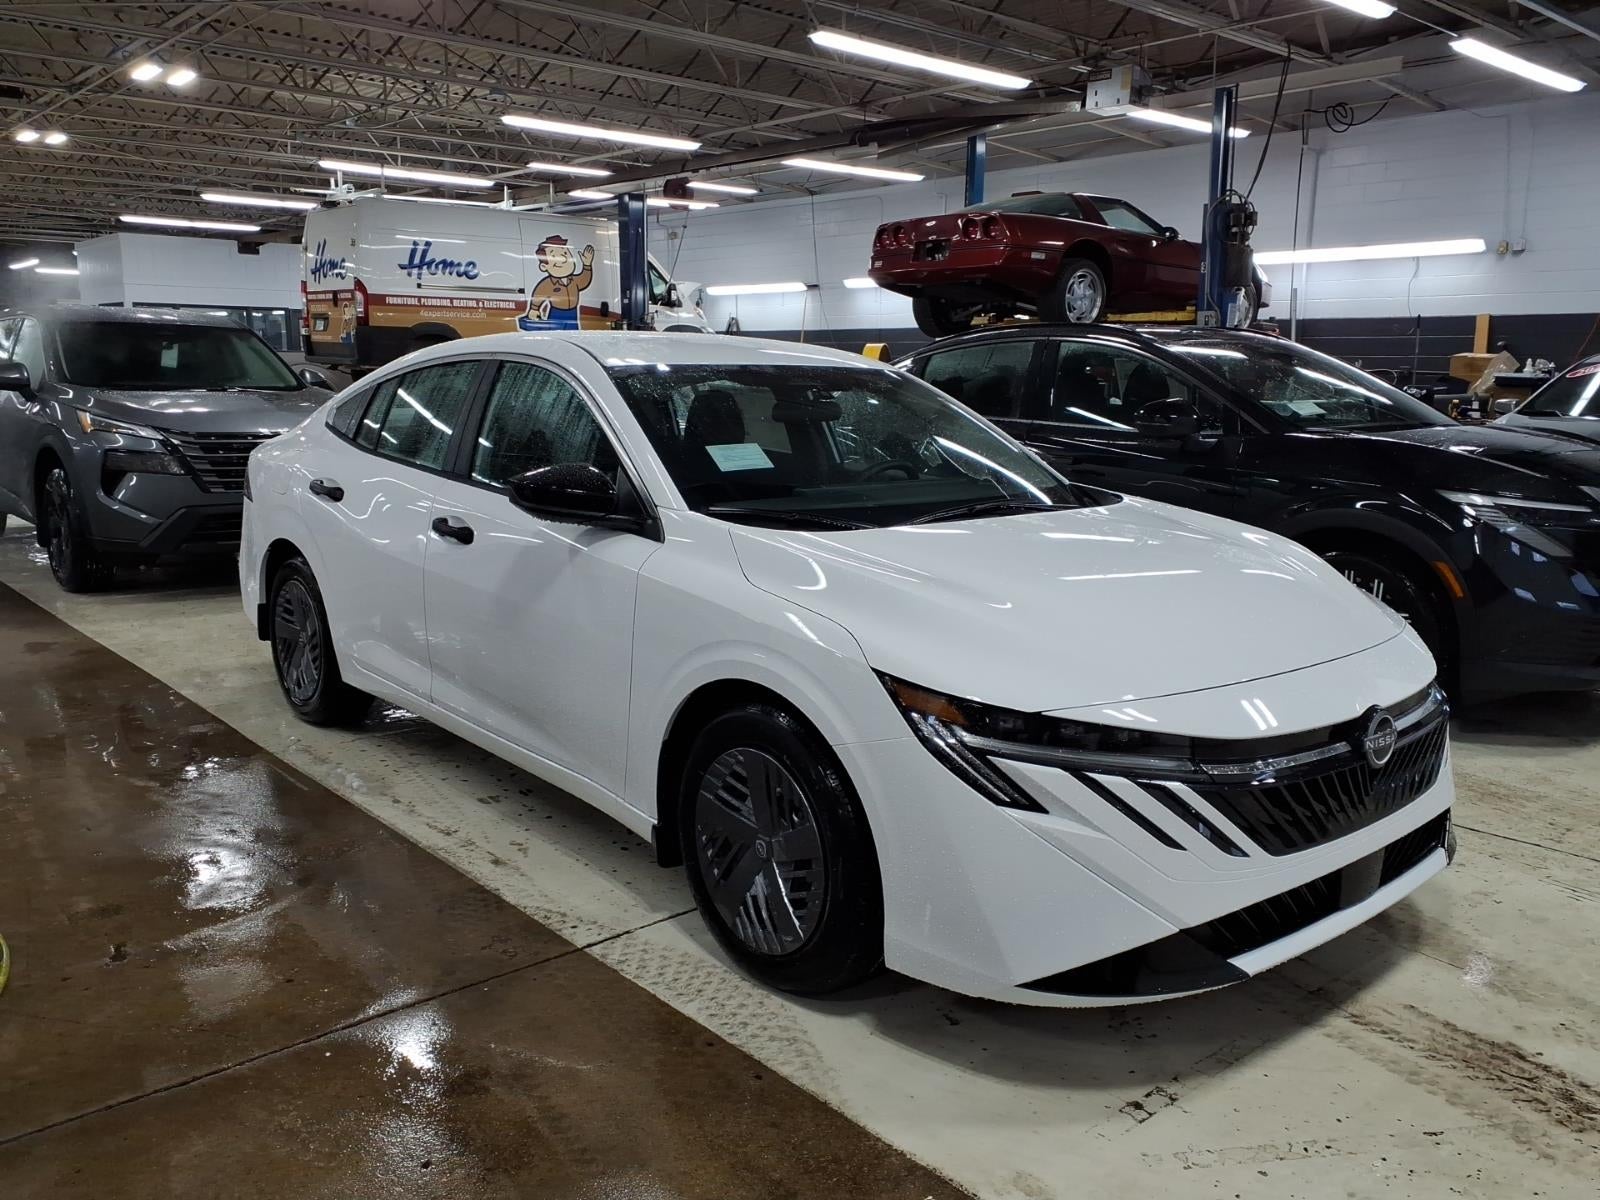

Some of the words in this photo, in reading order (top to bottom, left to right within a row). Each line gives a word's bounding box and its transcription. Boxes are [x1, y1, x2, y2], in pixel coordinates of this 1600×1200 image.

[310, 237, 348, 285] Home
[397, 240, 479, 280] Home
[421, 297, 452, 307] PLUMBING,
[484, 300, 516, 309] ELECTRICAL
[1366, 734, 1395, 750] NISSA
